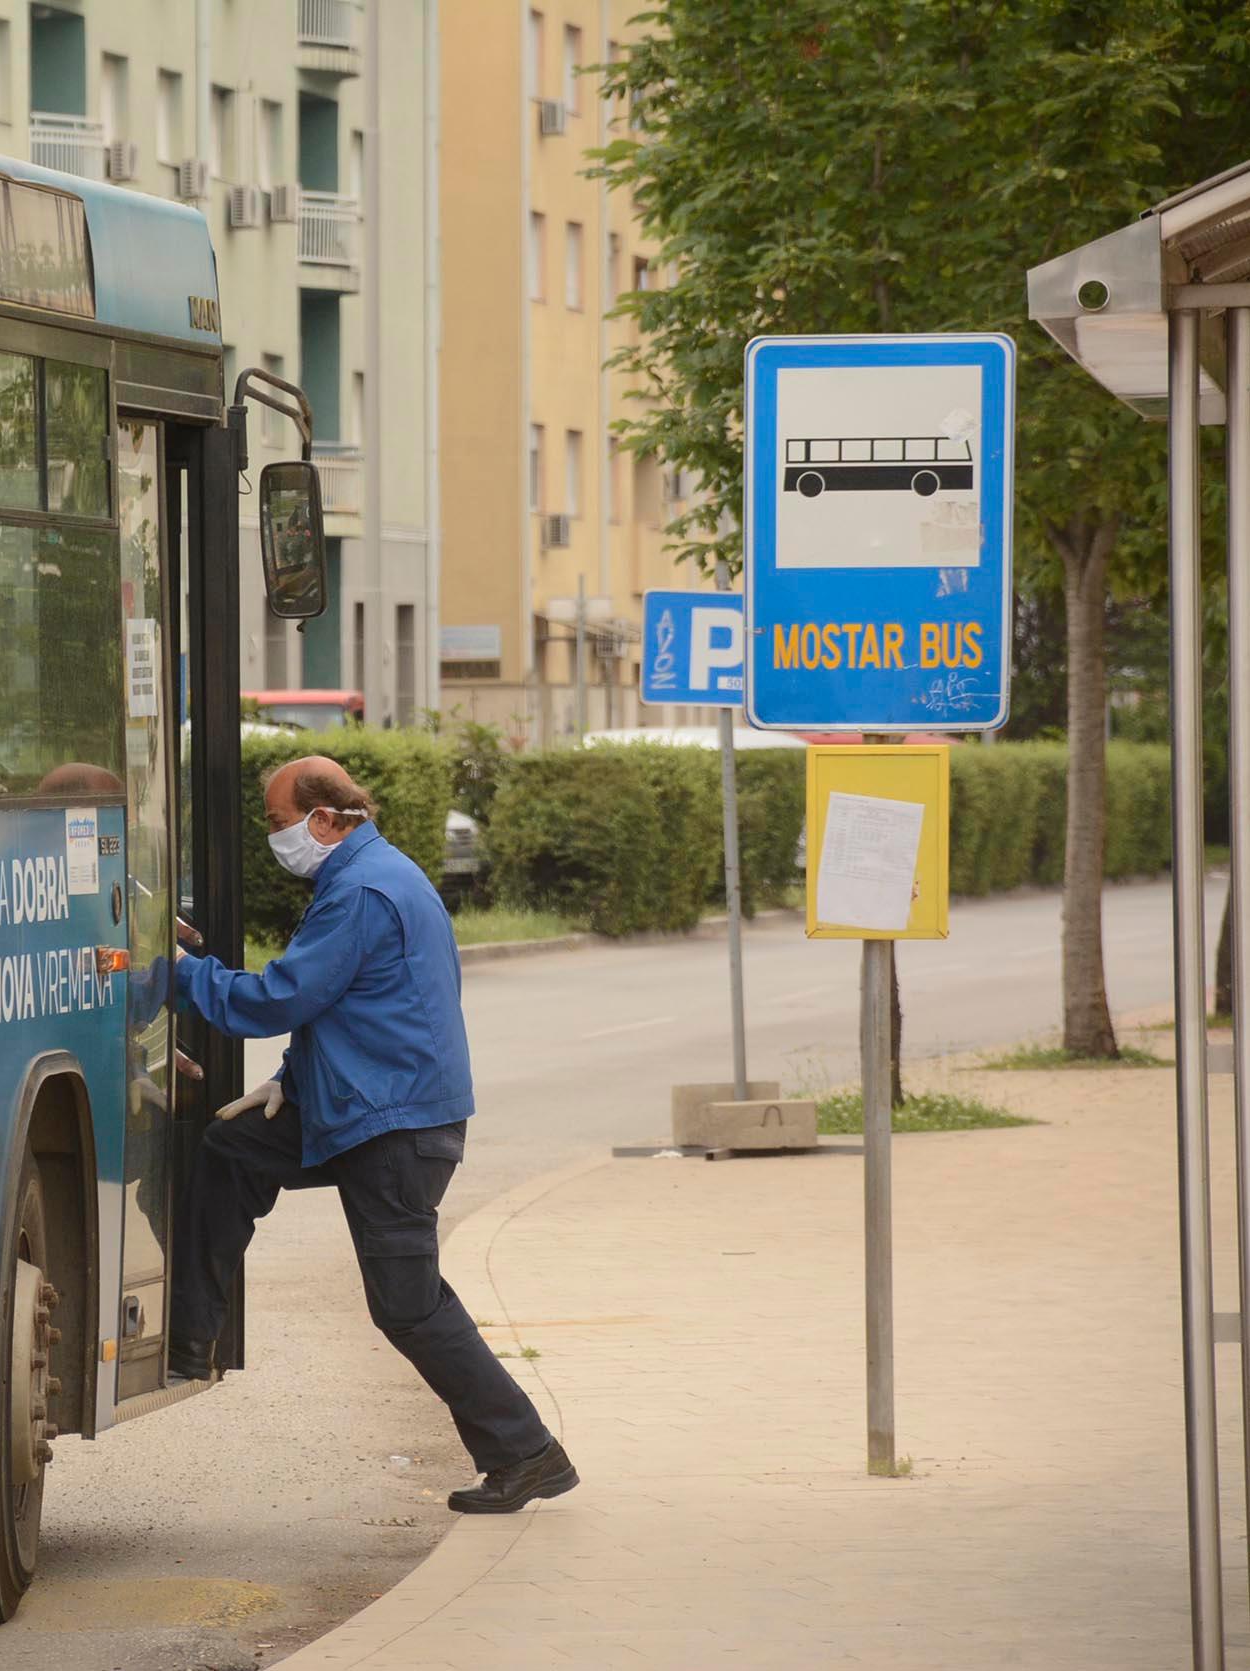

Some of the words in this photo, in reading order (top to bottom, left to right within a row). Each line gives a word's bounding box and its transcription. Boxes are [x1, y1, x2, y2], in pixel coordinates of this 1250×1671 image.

[689, 607, 743, 690] P
[773, 622, 905, 670] MOSTAR
[920, 622, 983, 669] BUS
[12, 855, 69, 924] DOBRA
